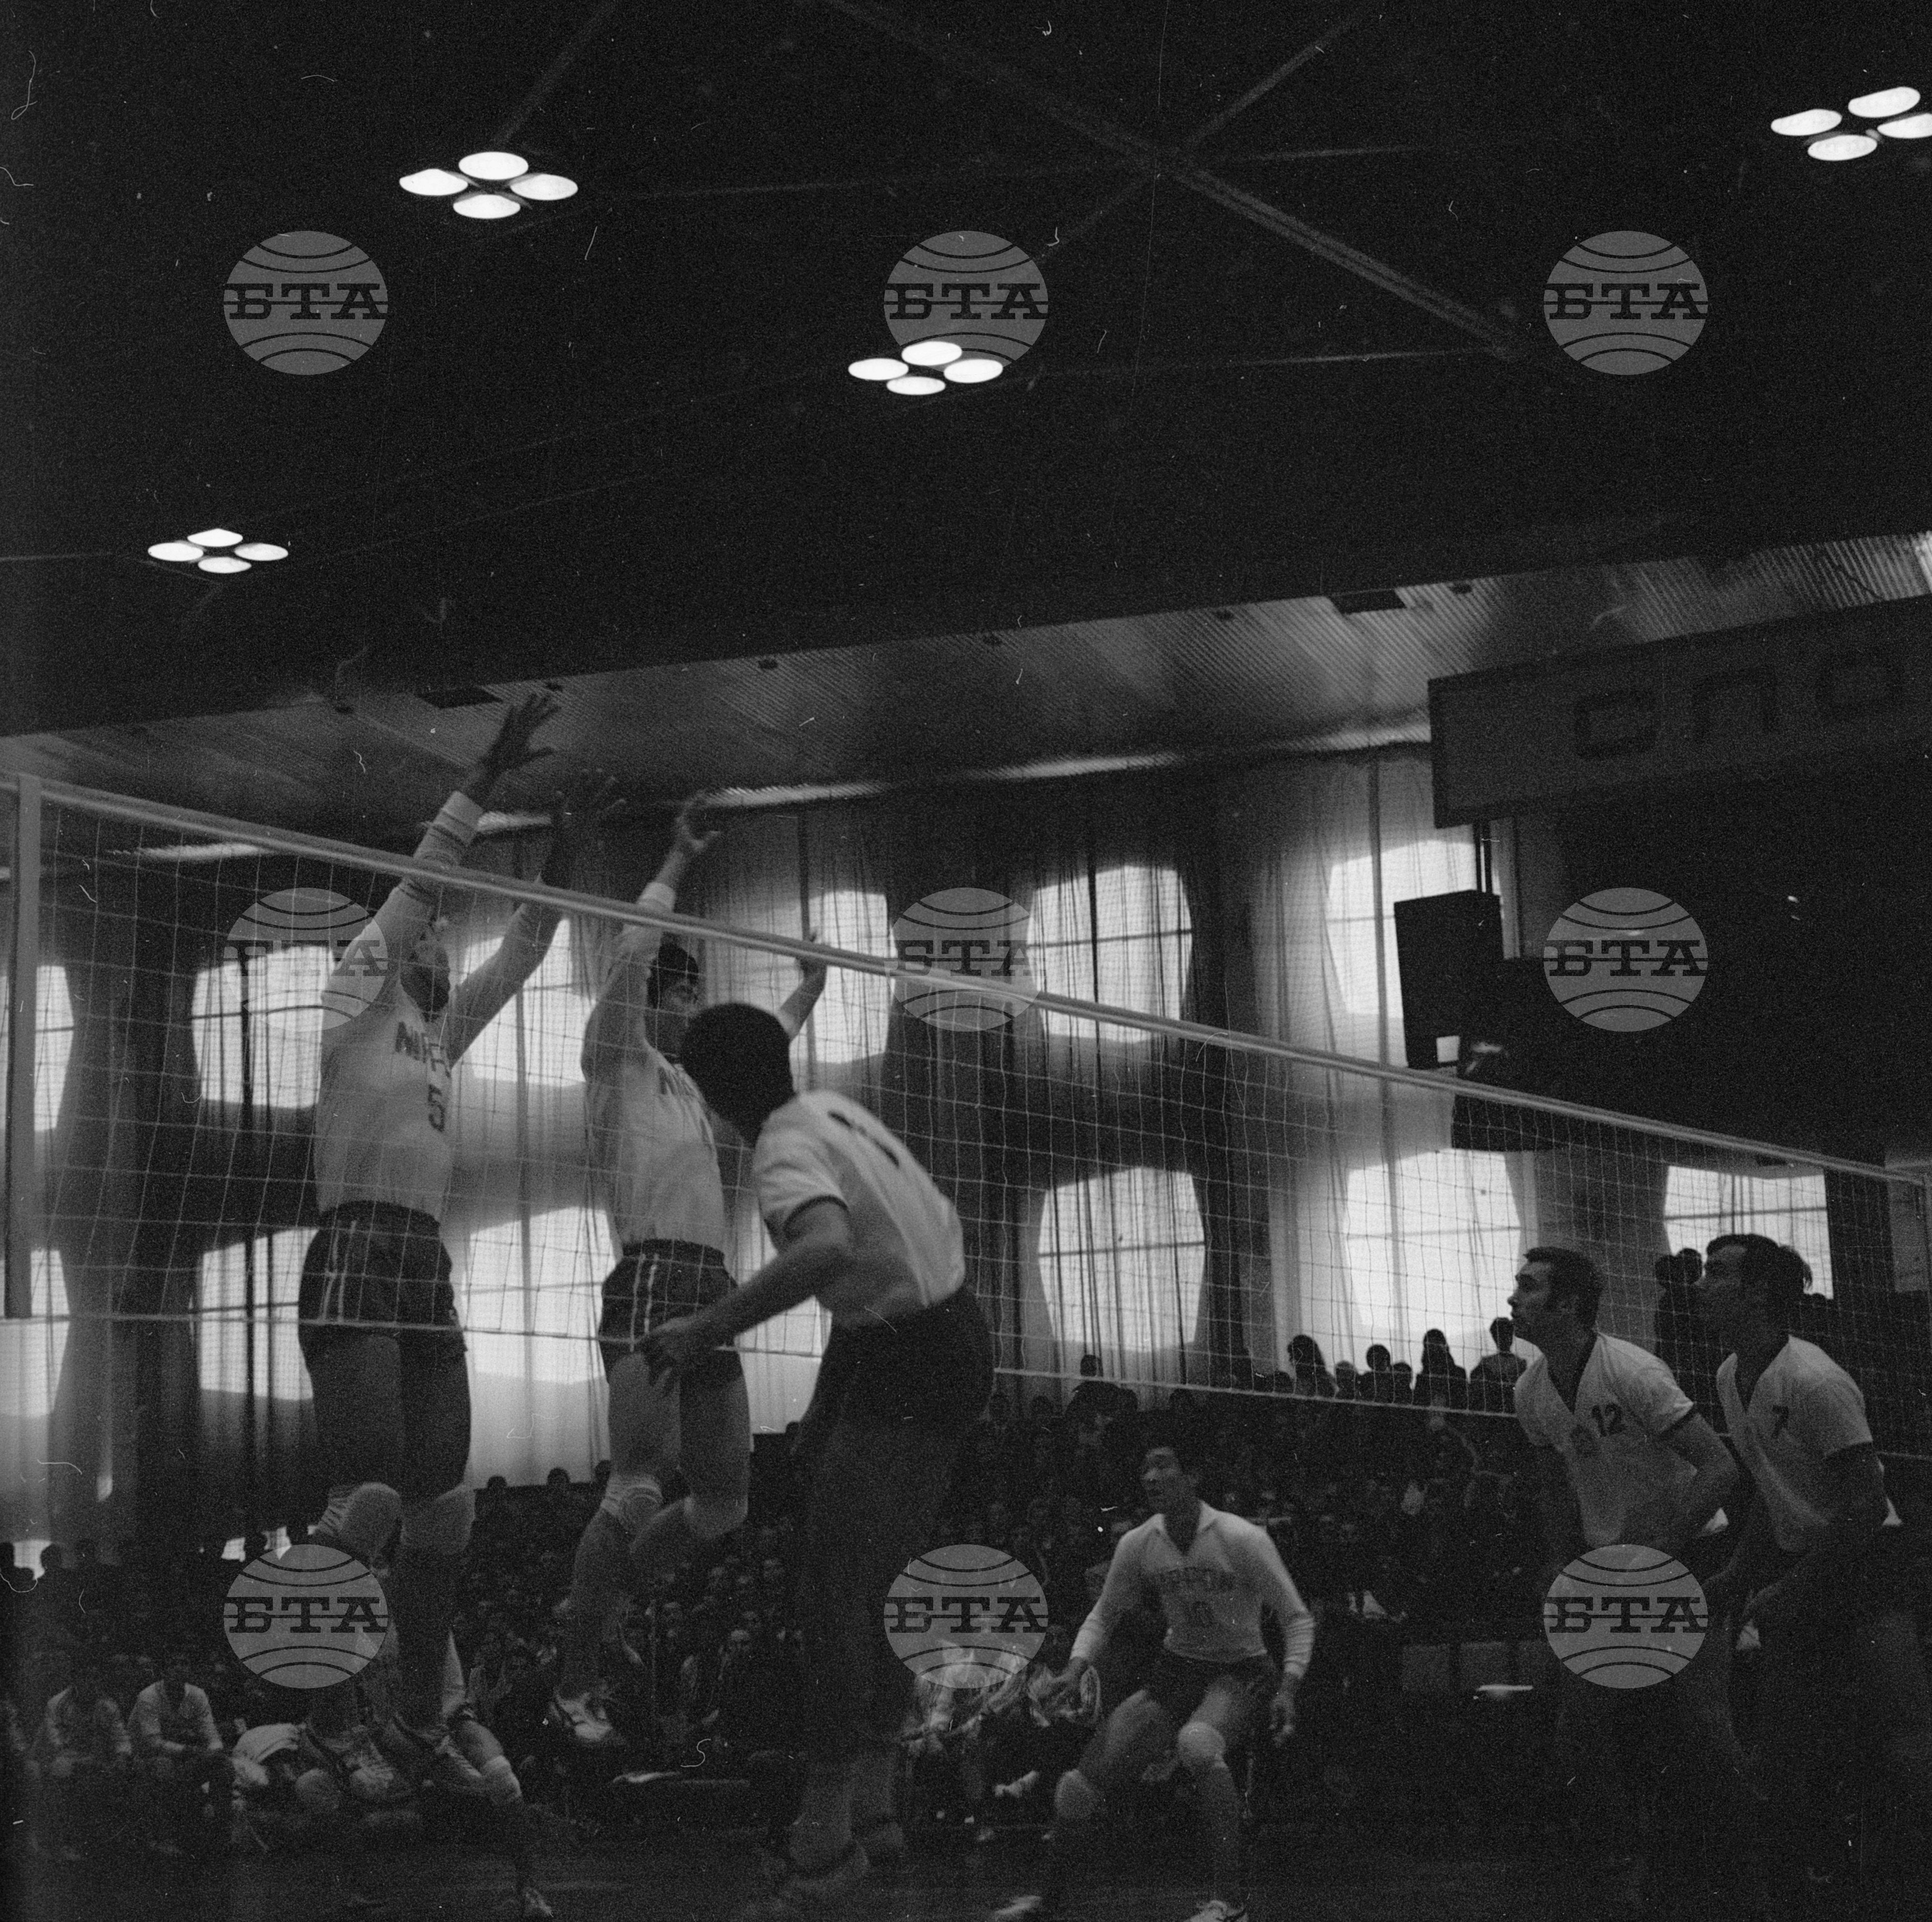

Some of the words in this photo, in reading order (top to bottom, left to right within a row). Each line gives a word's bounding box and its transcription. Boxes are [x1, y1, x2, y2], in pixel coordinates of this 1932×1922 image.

[427, 1084, 446, 1133] 5
[1591, 1401, 1626, 1438] 12
[1771, 1404, 1789, 1439] 7
